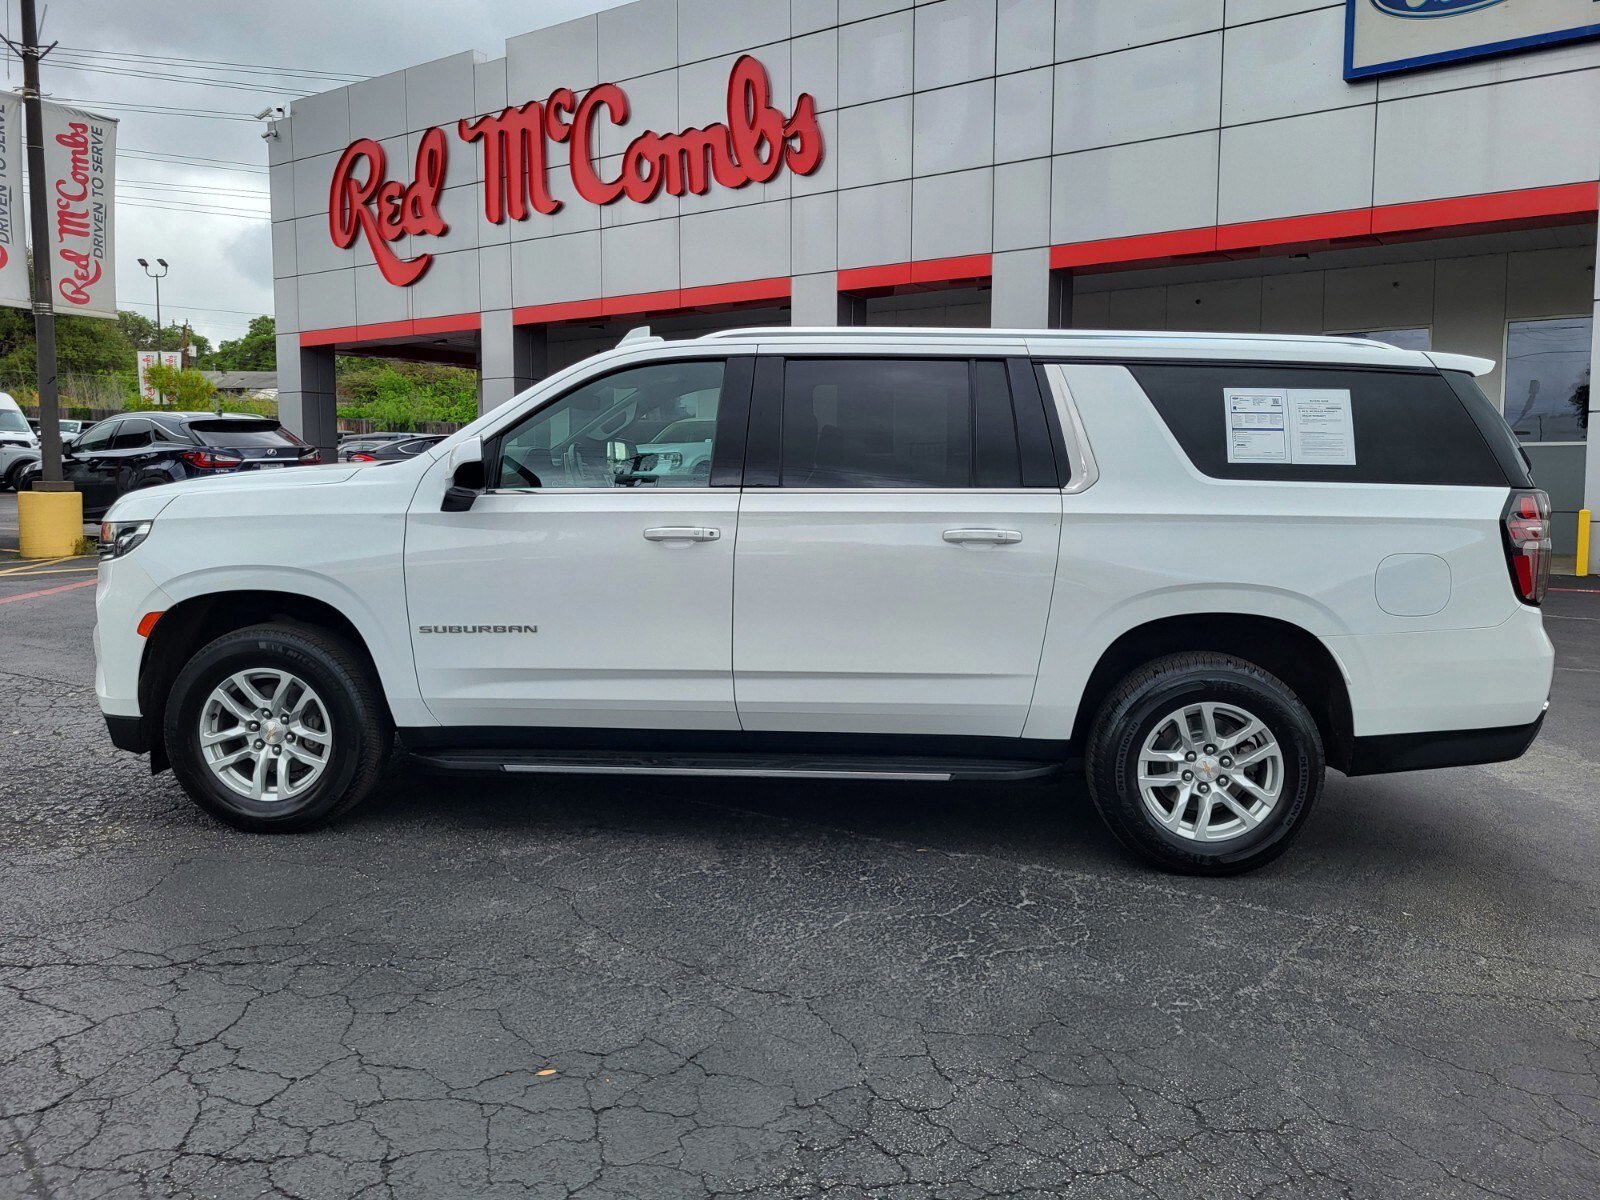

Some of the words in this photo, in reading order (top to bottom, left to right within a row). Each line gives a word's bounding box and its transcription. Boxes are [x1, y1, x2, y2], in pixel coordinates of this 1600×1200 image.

[91, 125, 104, 175] SERVE
[330, 126, 448, 287] Red
[458, 54, 823, 224] McCombs
[56, 122, 91, 243] McCombs
[92, 178, 105, 197] TO
[92, 202, 104, 260] DRIVEN
[59, 248, 103, 305] Red
[418, 625, 538, 634] SUBURBAN
